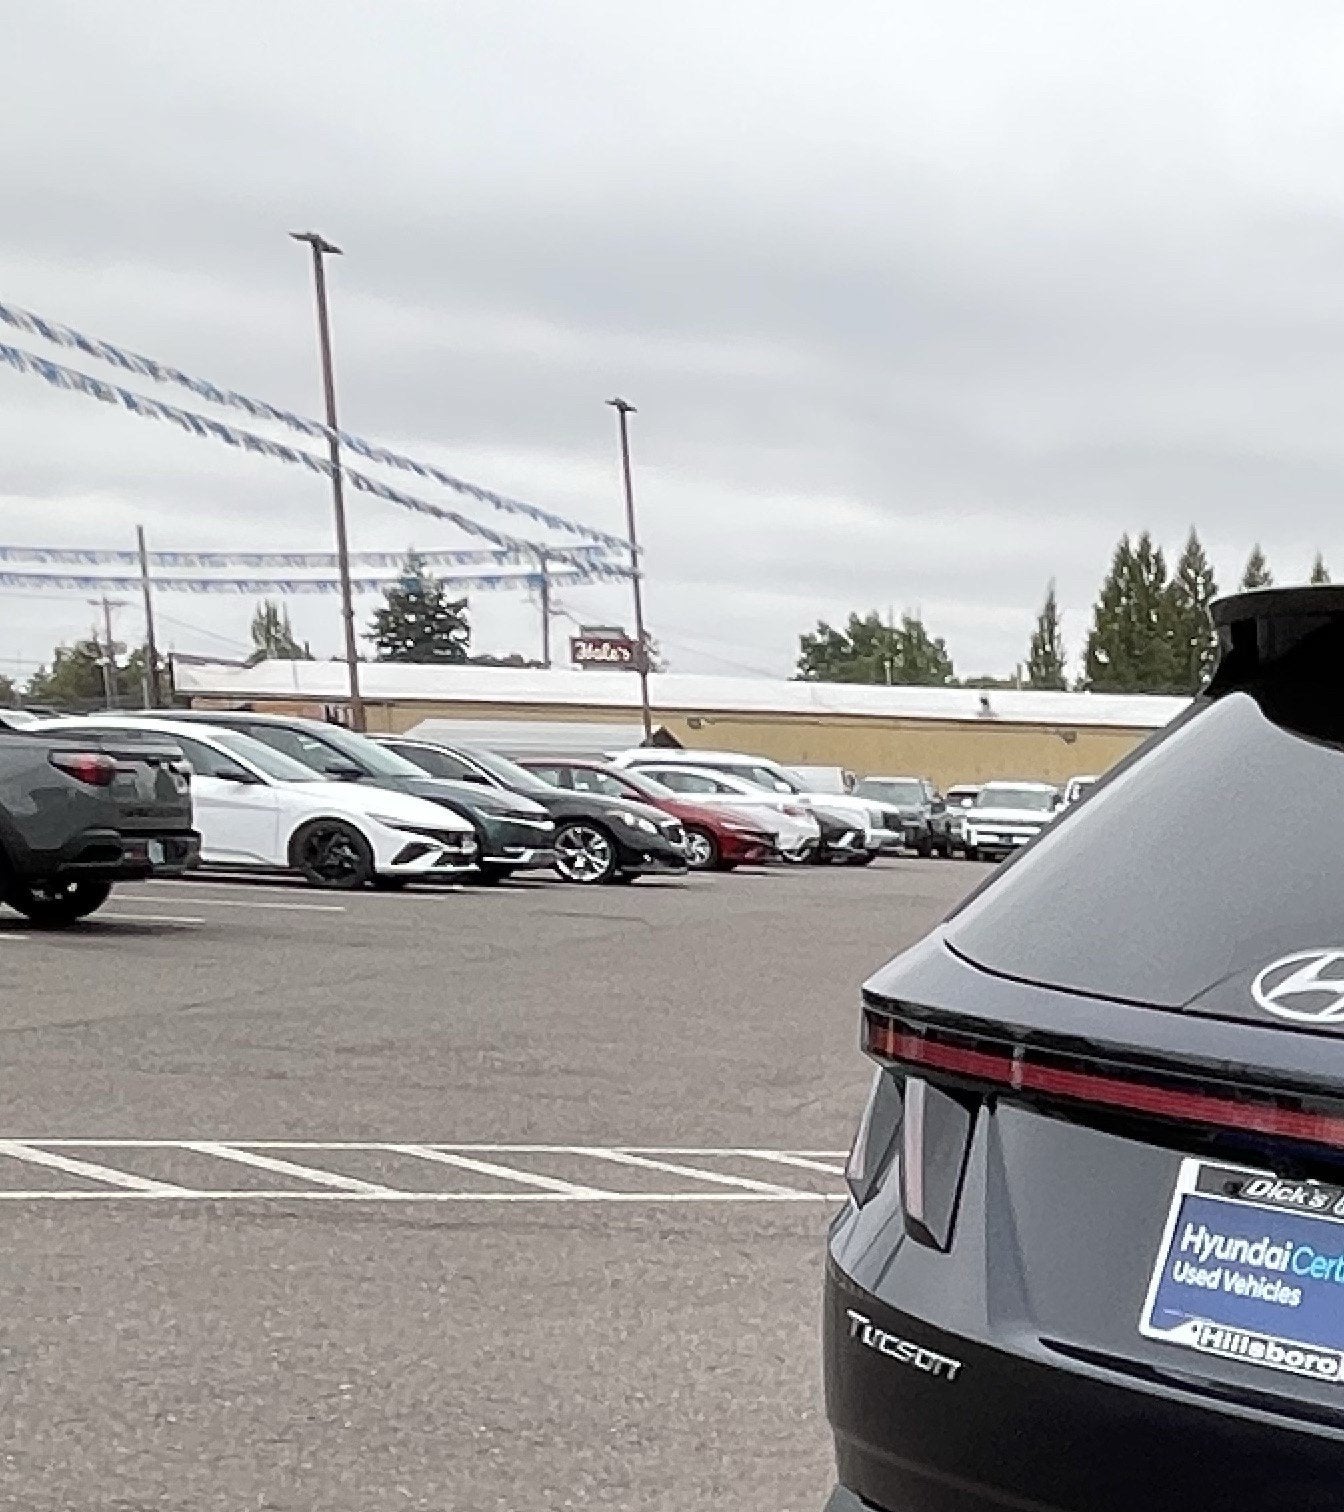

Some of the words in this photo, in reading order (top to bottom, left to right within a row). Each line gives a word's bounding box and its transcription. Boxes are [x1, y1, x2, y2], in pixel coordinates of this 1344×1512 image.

[1246, 1179, 1329, 1208] Dick's
[1181, 1223, 1291, 1272] Hyundai
[1172, 1260, 1220, 1290] Used
[1223, 1269, 1302, 1307] Vehicles
[1201, 1327, 1338, 1374] Hillsboro
